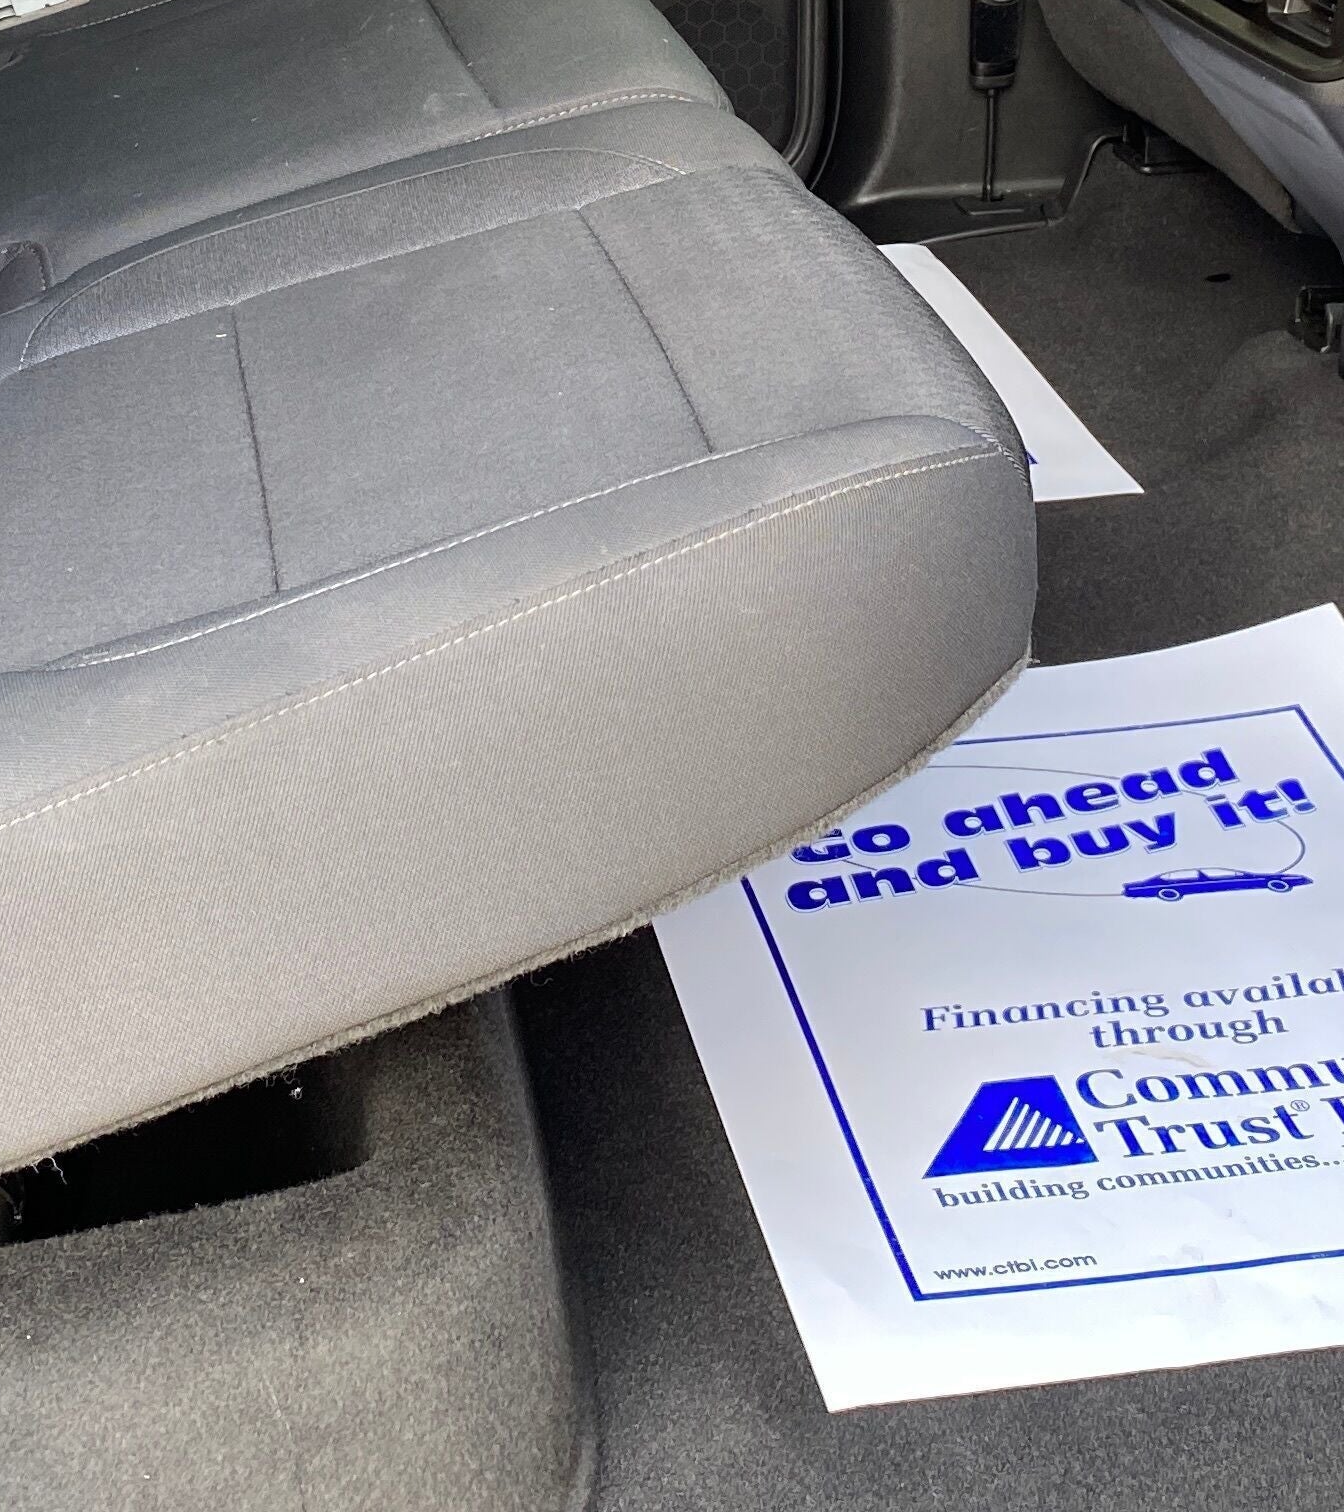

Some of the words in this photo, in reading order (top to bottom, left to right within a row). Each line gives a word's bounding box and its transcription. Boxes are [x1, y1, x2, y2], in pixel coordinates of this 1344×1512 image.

[943, 746, 1239, 837] ahead
[786, 847, 981, 912] and
[1005, 812, 1177, 872] buy
[1206, 778, 1317, 830] it!
[920, 991, 1170, 1031] Financing
[1089, 1009, 1290, 1048] through
[932, 1179, 1090, 1208] building
[933, 1254, 1098, 1280] www.ctbi.com
